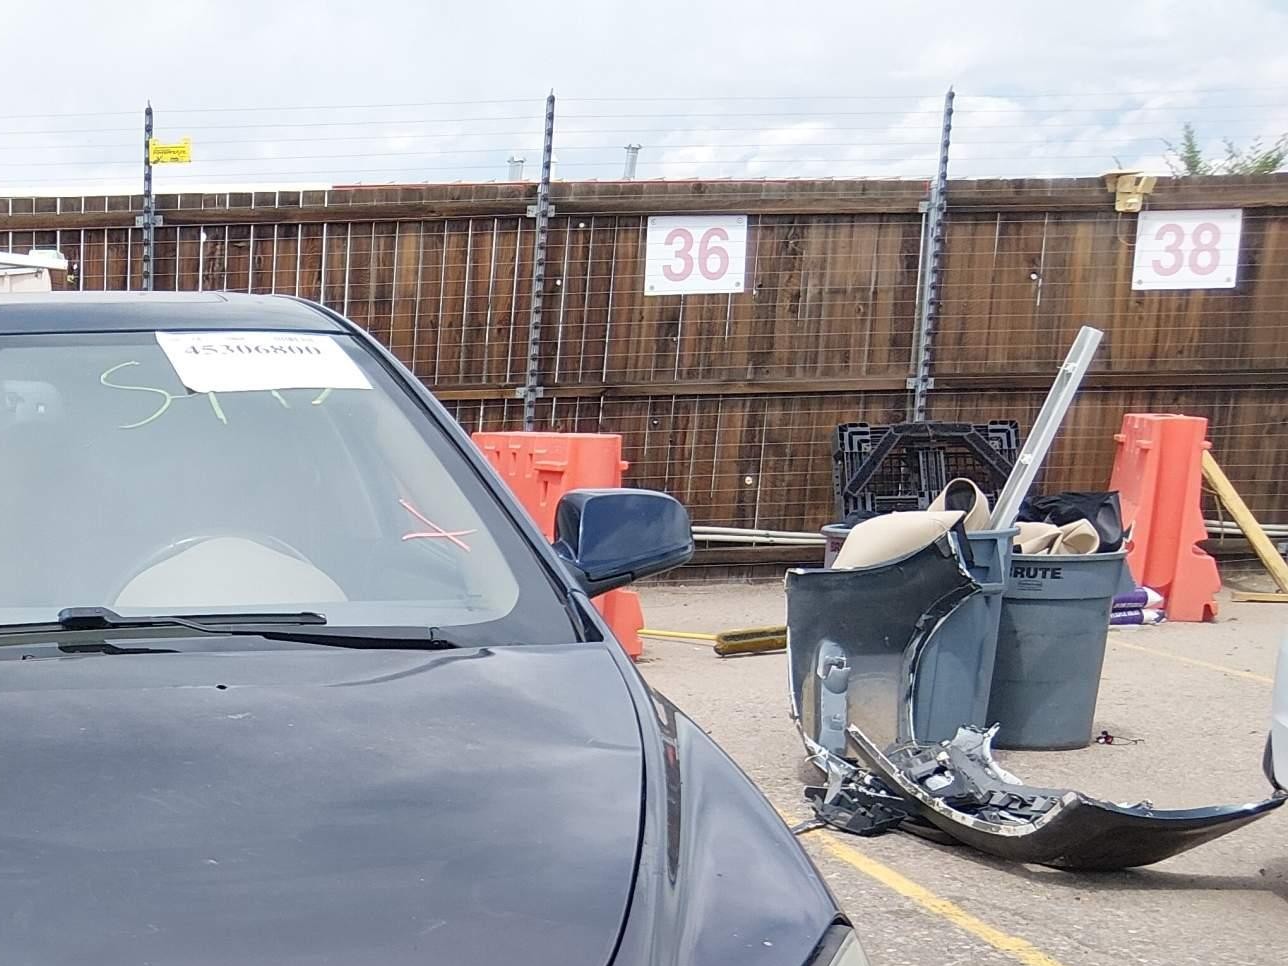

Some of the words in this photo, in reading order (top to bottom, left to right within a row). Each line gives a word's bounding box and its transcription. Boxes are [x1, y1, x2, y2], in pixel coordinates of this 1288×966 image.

[662, 227, 730, 282] 36
[1151, 222, 1221, 277] 38
[184, 344, 321, 356] 45306800
[1010, 566, 1065, 580] RUTE
